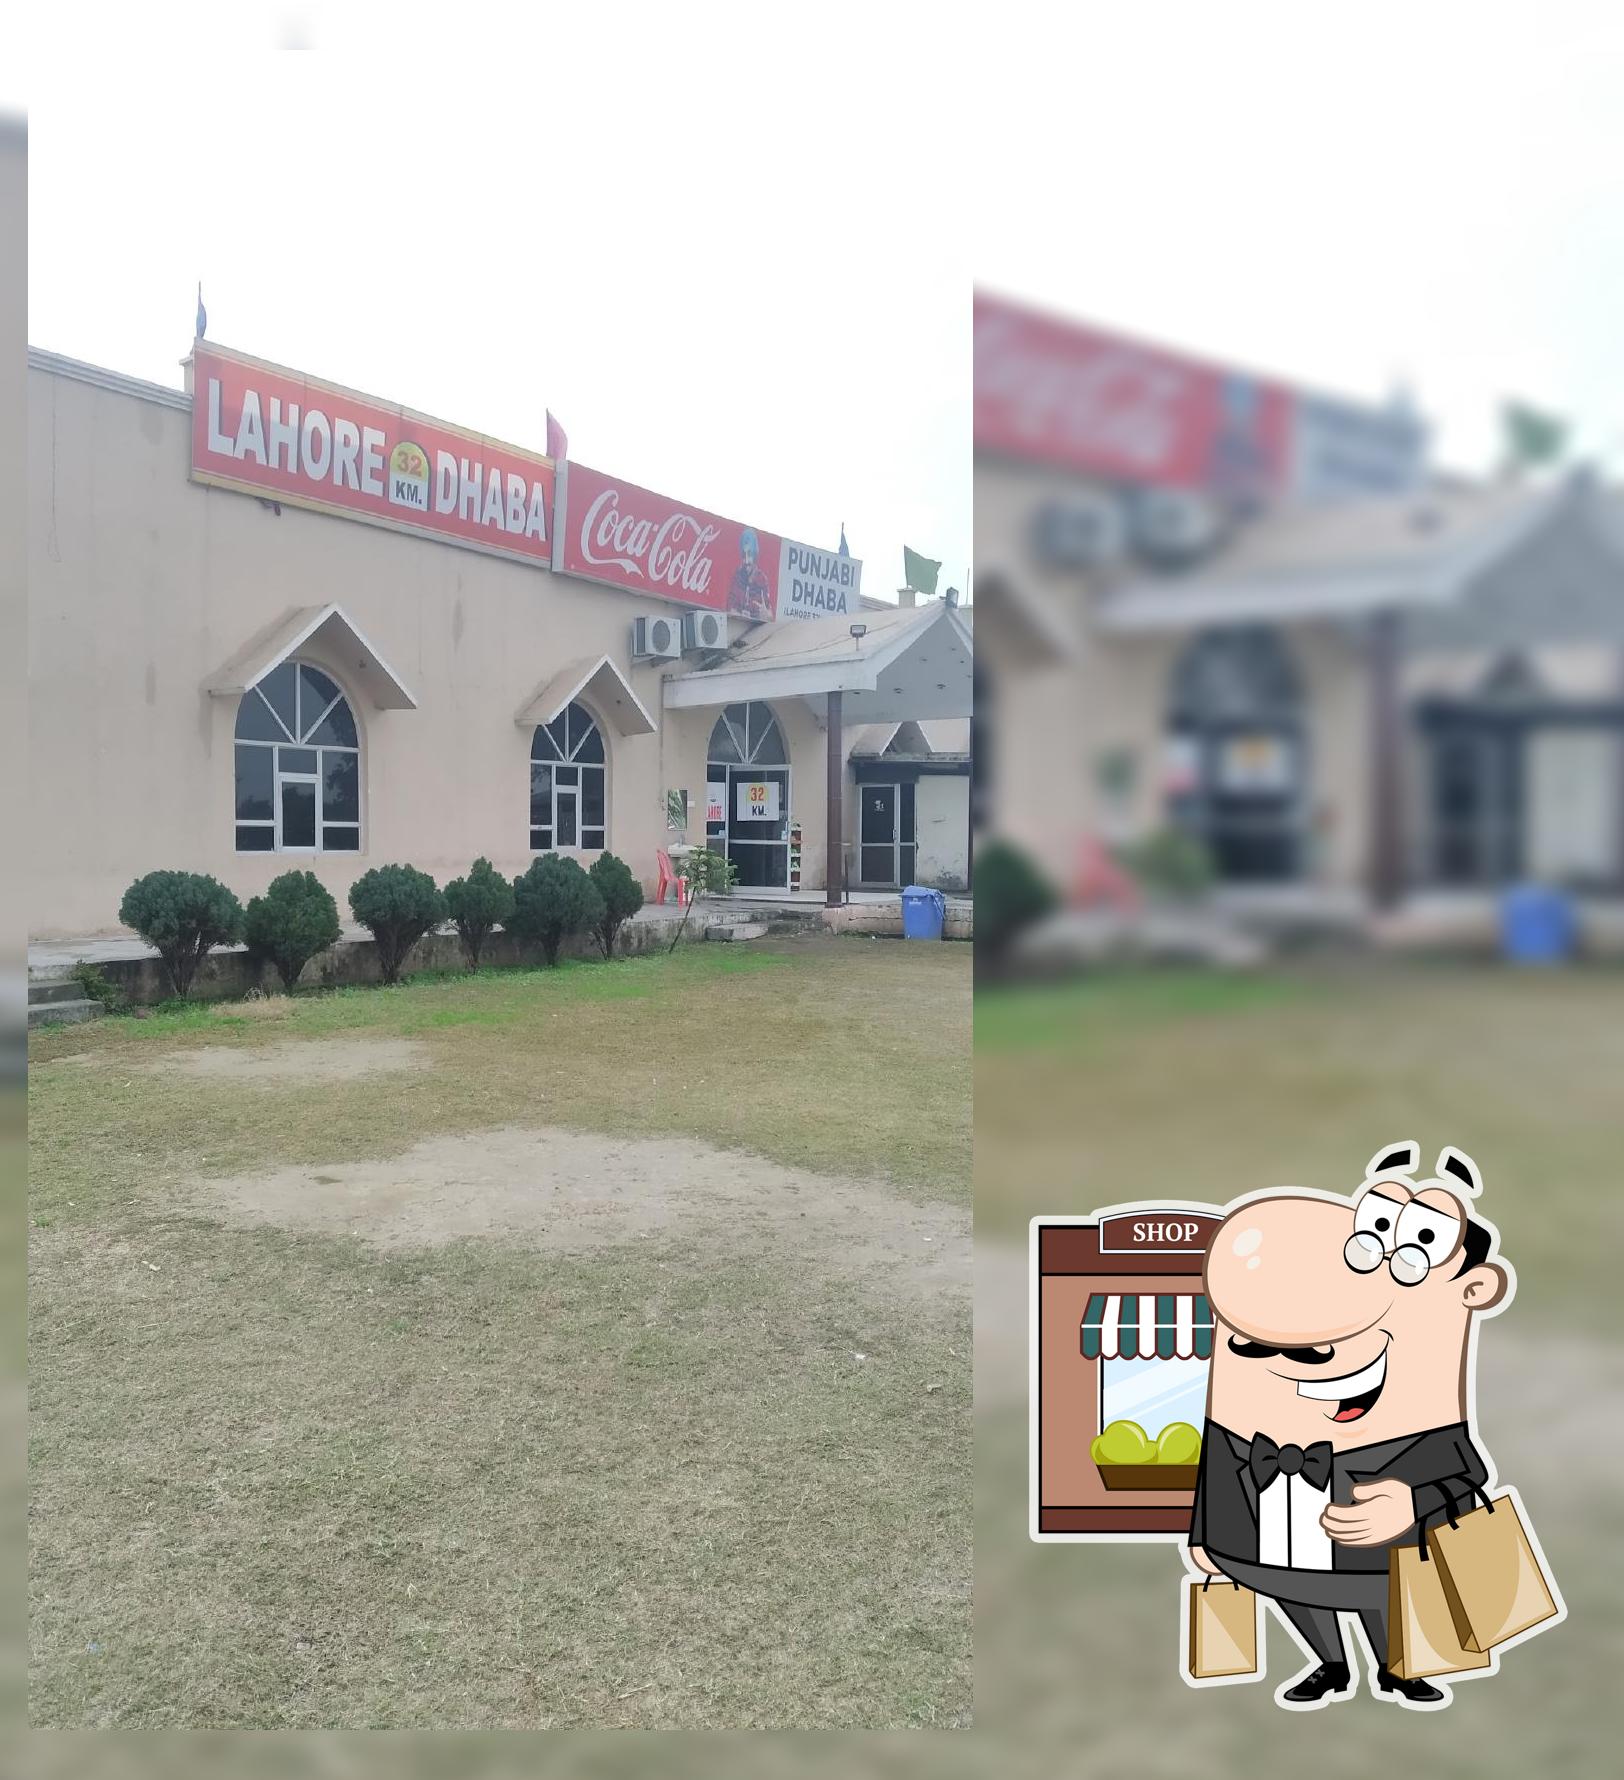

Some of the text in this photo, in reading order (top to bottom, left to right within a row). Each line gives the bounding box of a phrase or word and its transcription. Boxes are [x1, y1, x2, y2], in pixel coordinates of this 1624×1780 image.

[207, 378, 547, 542] LAHORE DHABA
[397, 450, 422, 475] 32
[395, 480, 423, 506] KM.
[787, 547, 855, 588] PUNJABI
[791, 580, 847, 614] DHABA
[750, 787, 765, 802] 32
